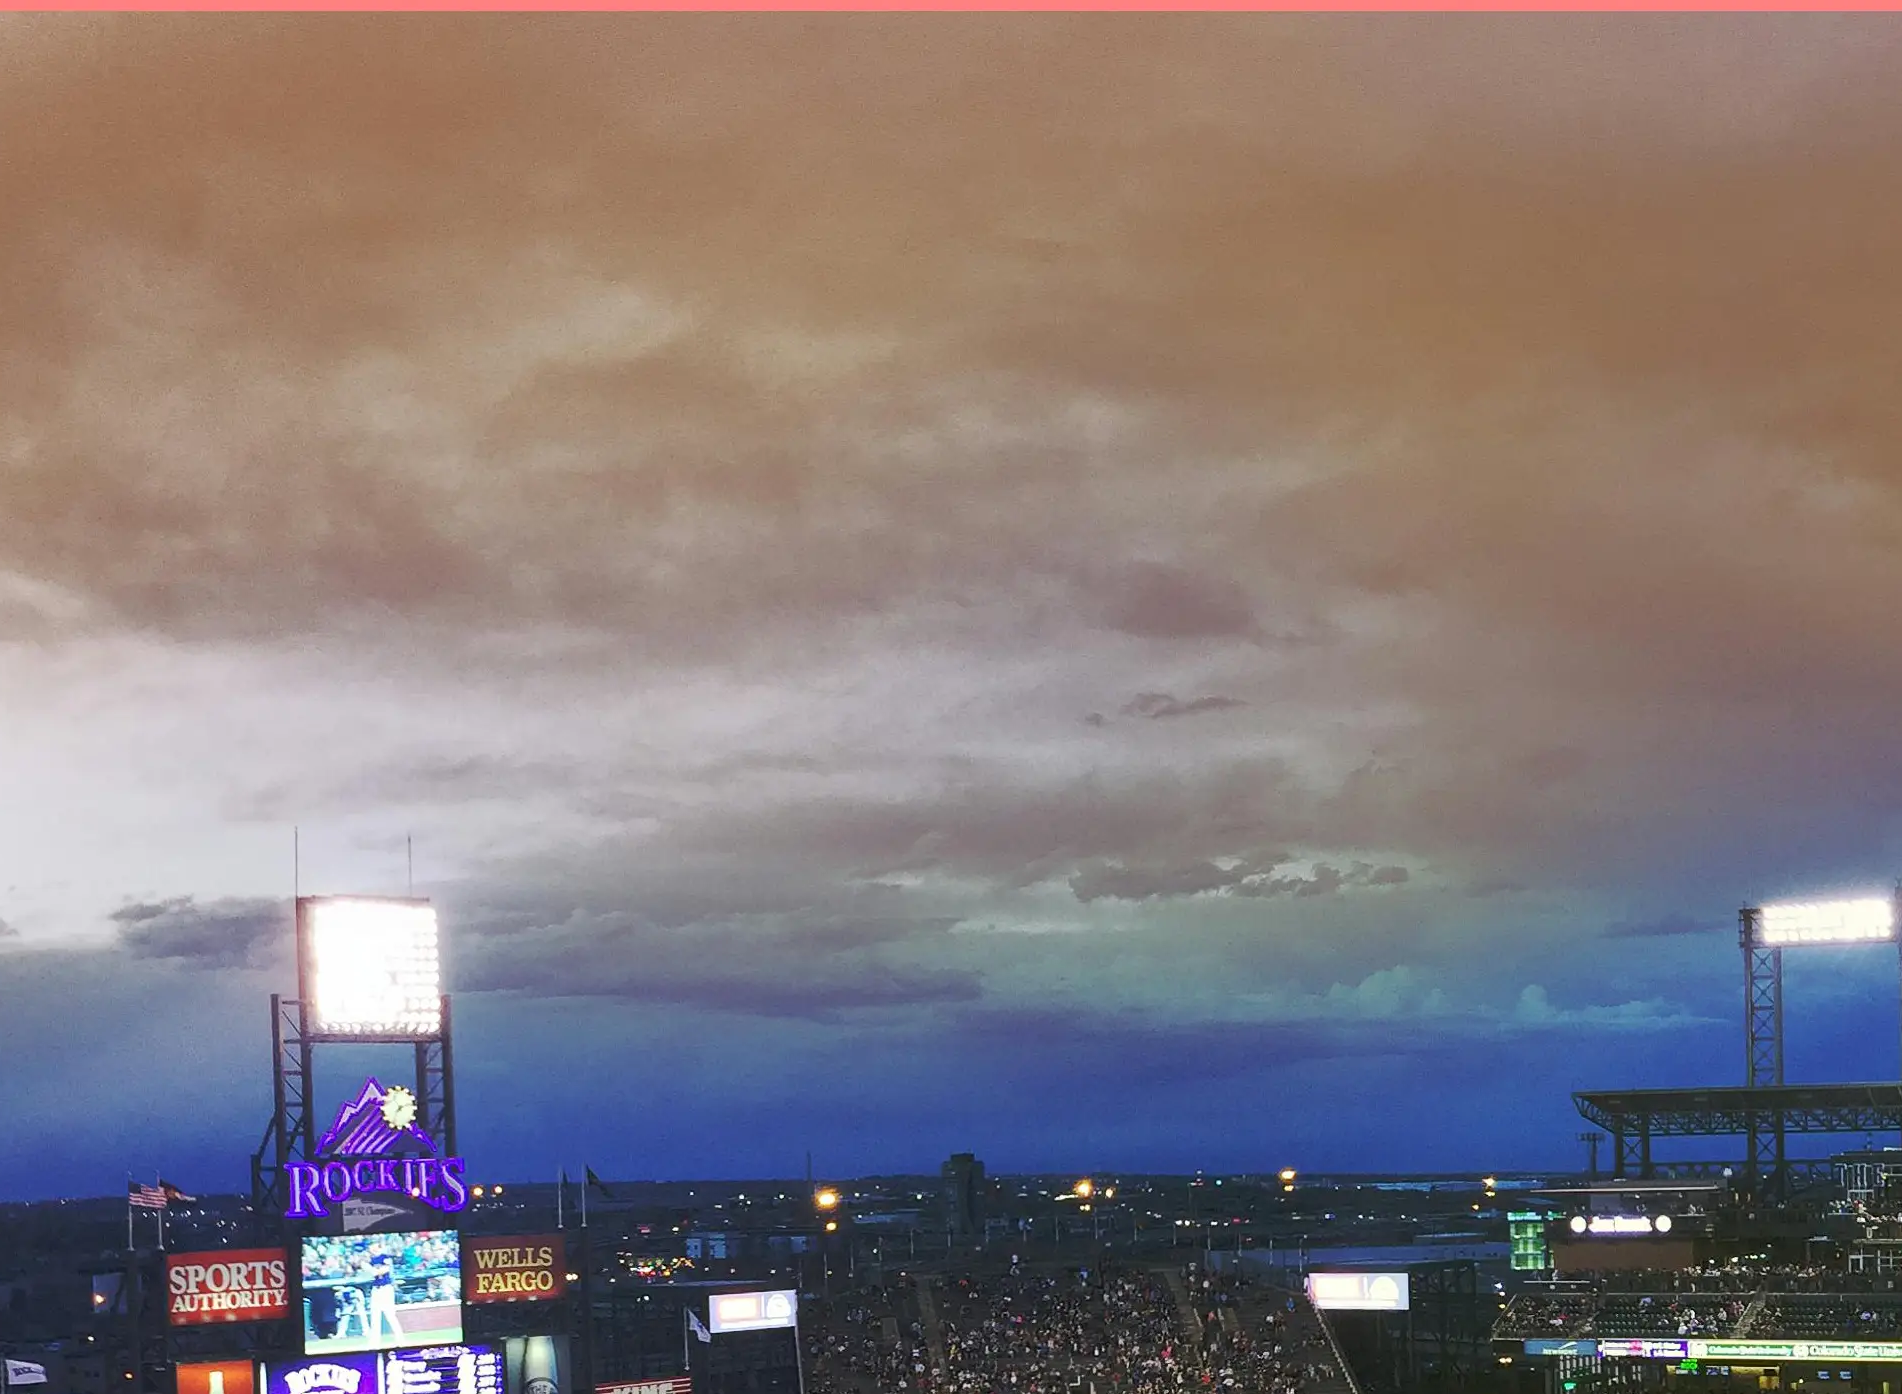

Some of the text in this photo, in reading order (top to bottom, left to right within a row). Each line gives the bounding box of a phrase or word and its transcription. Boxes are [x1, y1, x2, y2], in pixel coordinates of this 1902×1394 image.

[283, 1157, 469, 1217] ROCKIES
[473, 1247, 553, 1270] WELLS
[169, 1260, 286, 1294] SPORTS
[476, 1271, 554, 1293] FARGO
